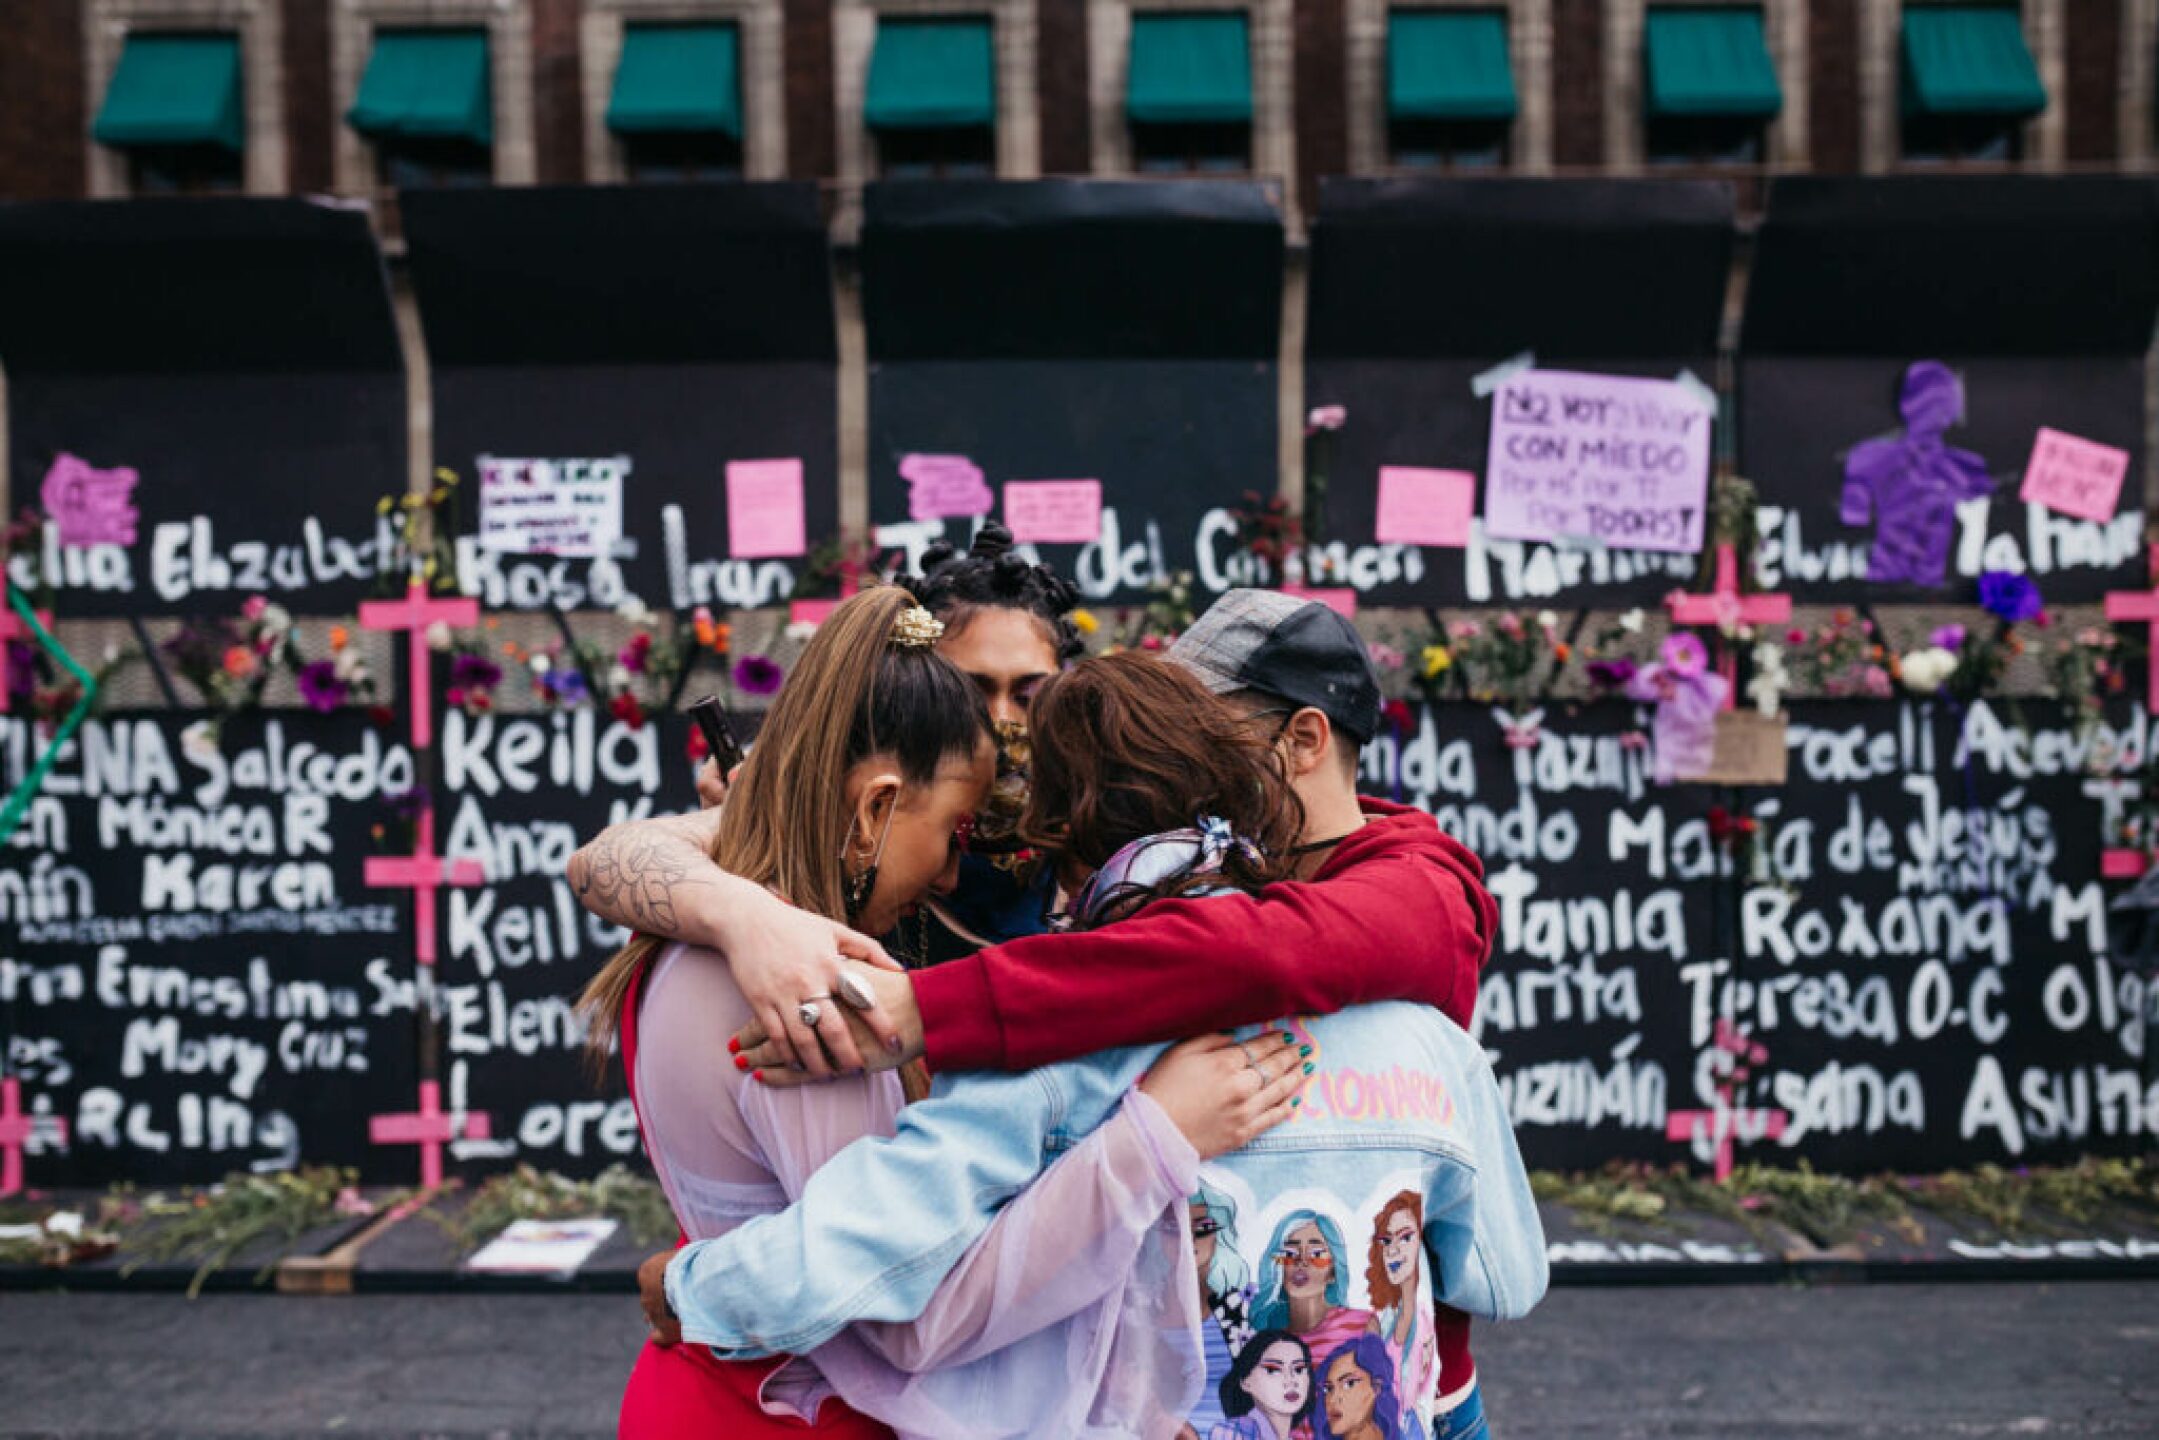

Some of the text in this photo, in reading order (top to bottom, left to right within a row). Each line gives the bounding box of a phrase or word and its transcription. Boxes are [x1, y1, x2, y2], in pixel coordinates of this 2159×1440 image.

[1506, 434, 1567, 461] CON
[443, 706, 661, 797] Keila
[1359, 704, 1476, 798] nda
[284, 793, 333, 856] R
[445, 794, 578, 883] Ana
[1828, 792, 1895, 873] de
[142, 852, 334, 912] Karen
[1487, 864, 1687, 962] Tania
[1741, 886, 2012, 966] Roxana
[446, 980, 618, 1056] Elen
[1468, 952, 1643, 1045] arita
[277, 1018, 370, 1075] Cruz
